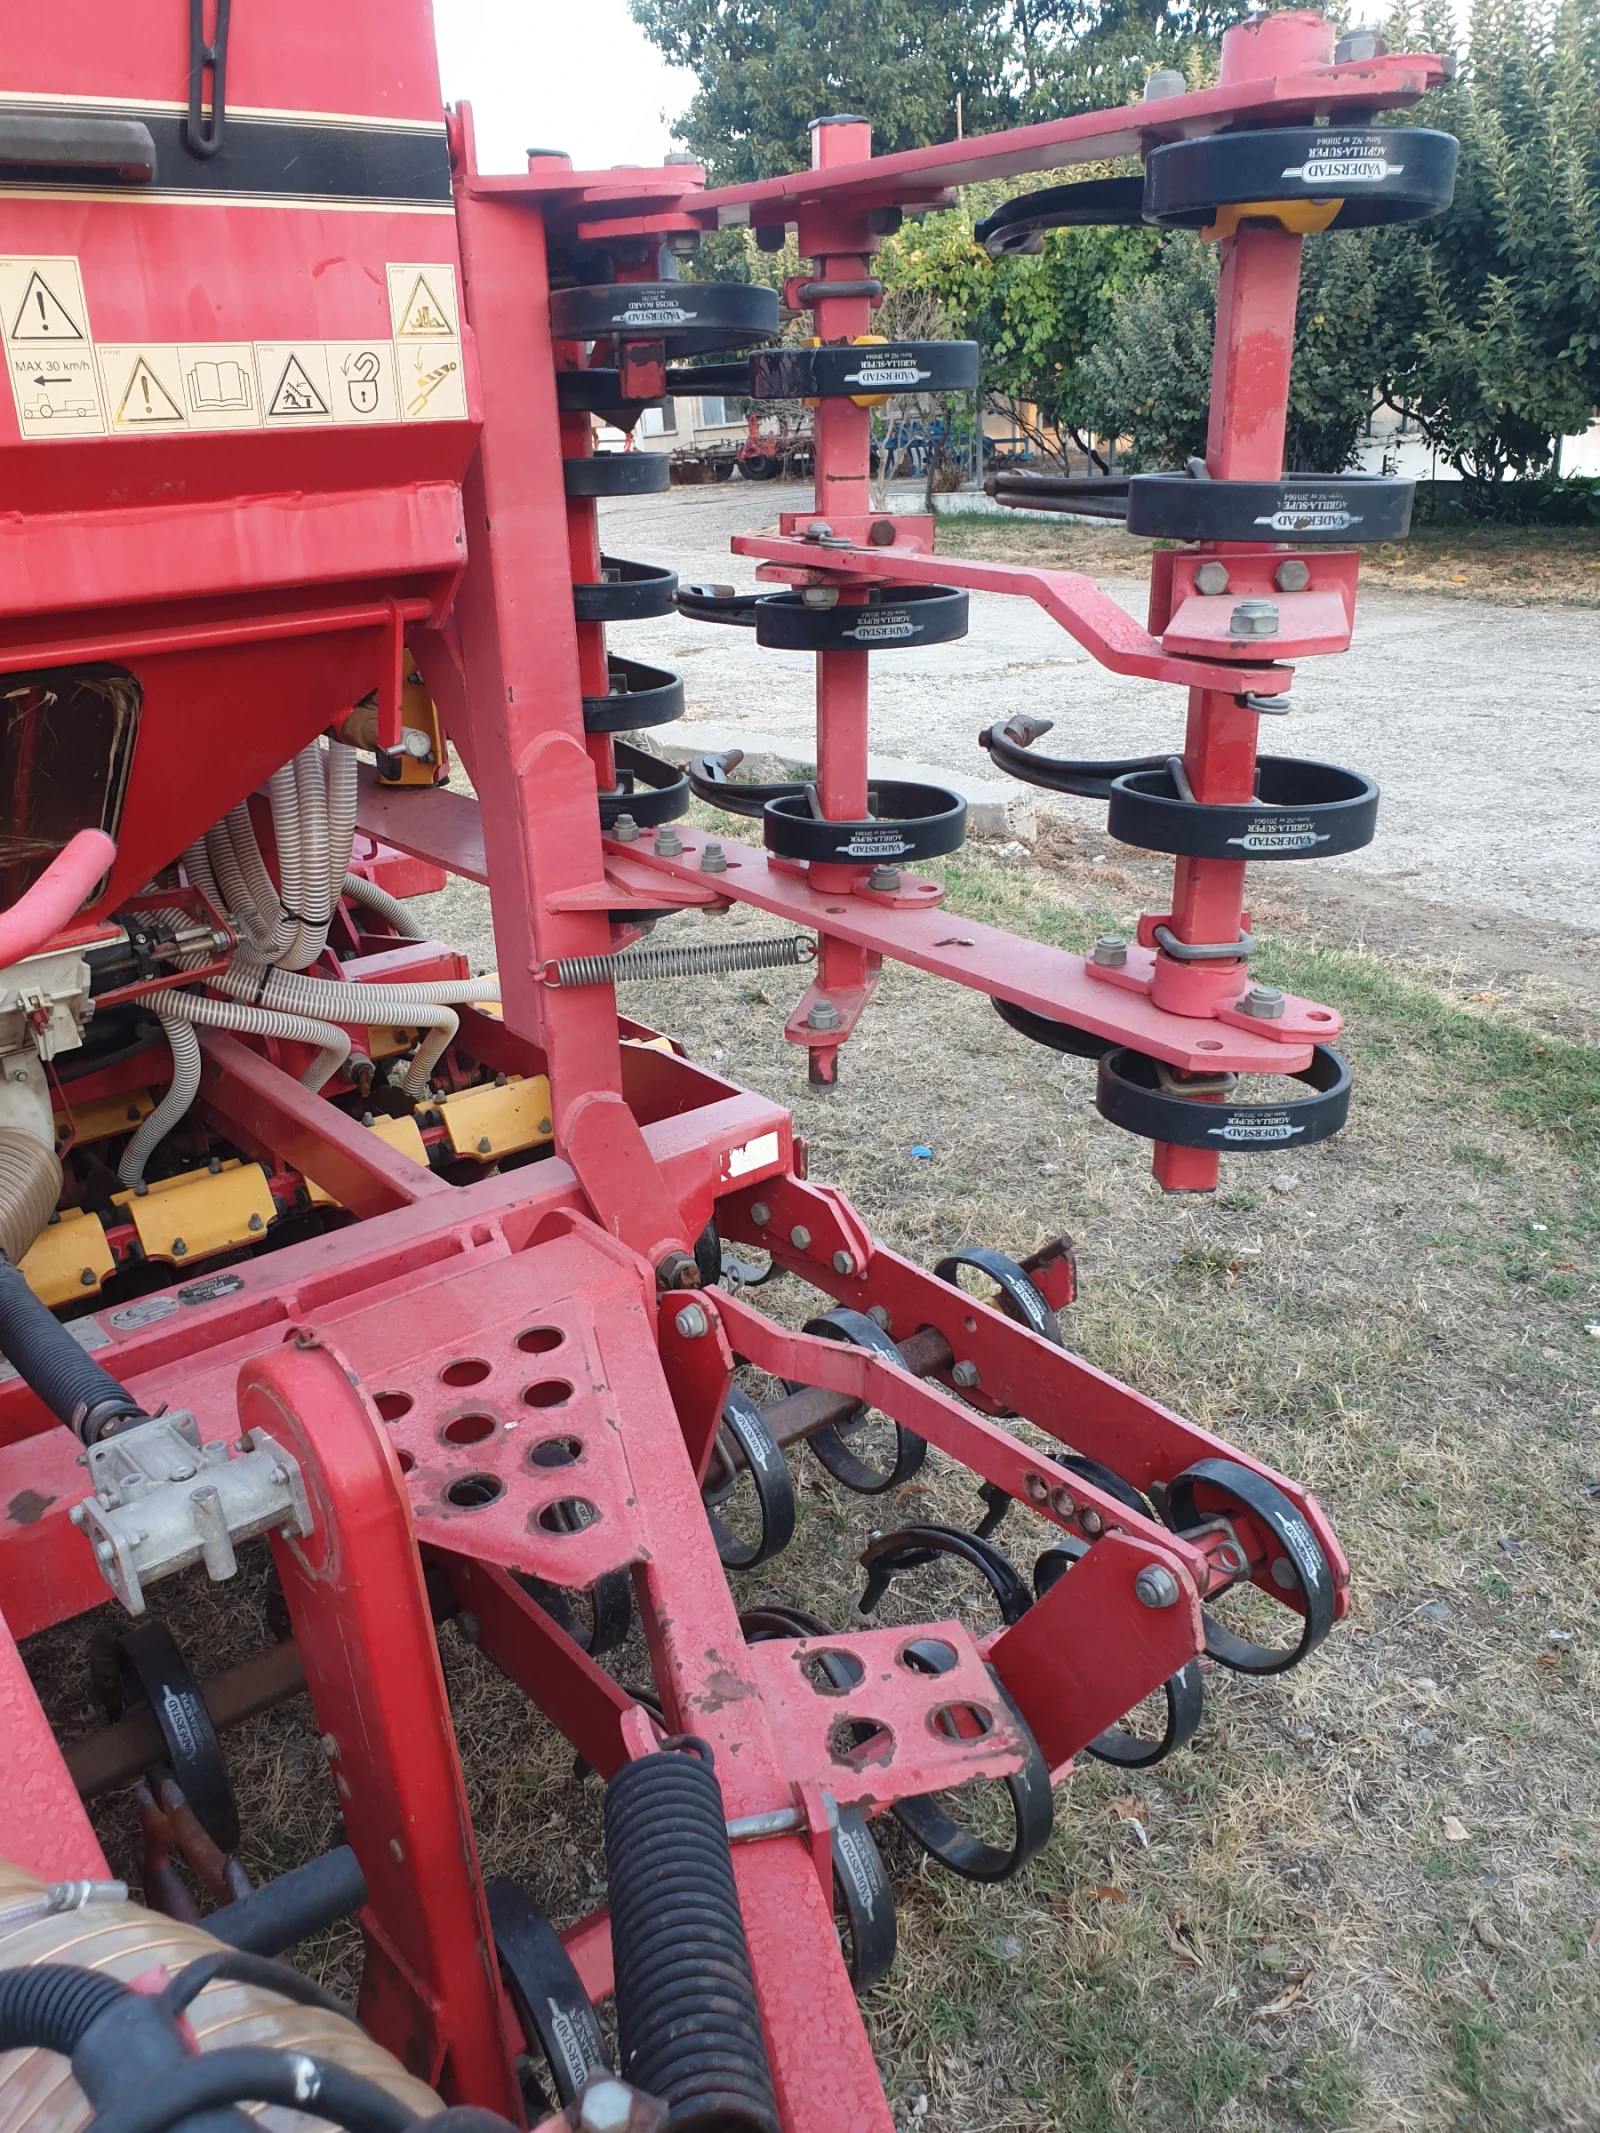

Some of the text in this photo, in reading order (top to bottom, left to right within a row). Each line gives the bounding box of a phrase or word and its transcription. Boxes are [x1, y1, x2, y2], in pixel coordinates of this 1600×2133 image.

[1317, 137, 1341, 146] 201064
[628, 300, 679, 310] CROSS BOARD
[15, 360, 90, 372] MAX 30 km/h
[860, 360, 918, 369] AGRILLA-SUPER
[857, 615, 911, 625] AGRILLA-SUPER
[1254, 817, 1278, 825] 201064
[1247, 823, 1316, 832] AGRILLA-SUPER
[850, 834, 903, 843] AGRILLA-SUPER
[1227, 1116, 1291, 1126] AGRILLA-SUPER
